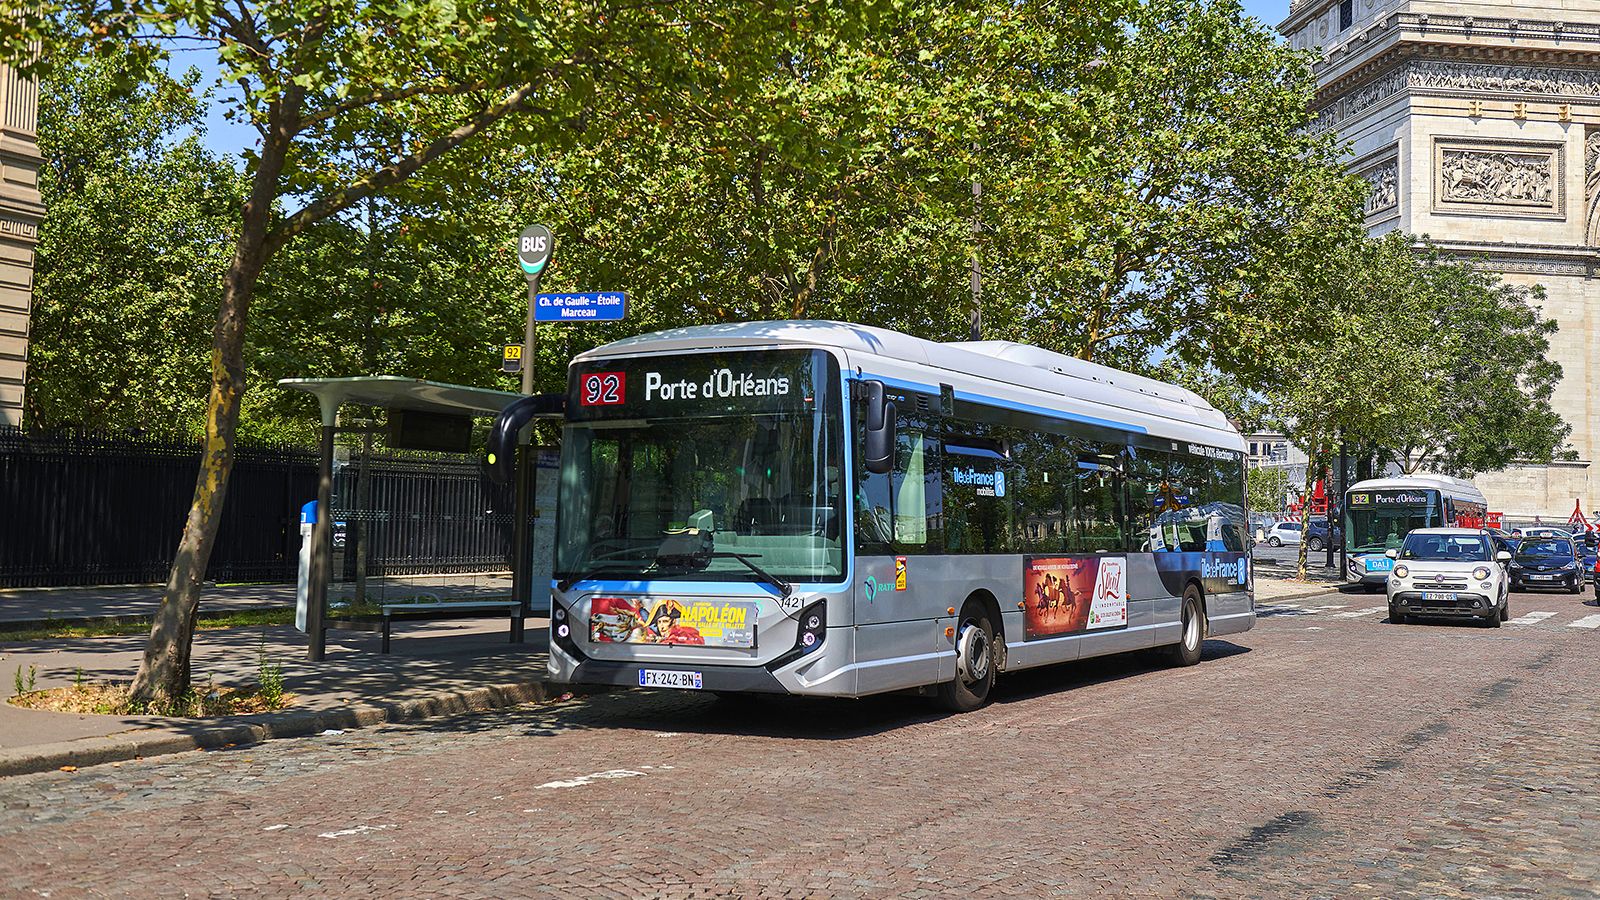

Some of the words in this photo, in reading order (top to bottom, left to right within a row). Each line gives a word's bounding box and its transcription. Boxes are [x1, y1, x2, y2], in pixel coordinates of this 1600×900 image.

[521, 236, 547, 253] BUS
[539, 297, 552, 307] Ch.
[553, 296, 563, 306] de
[565, 296, 590, 306] Gaulle
[597, 294, 620, 305] Étoile
[561, 307, 597, 318] Marceau
[507, 348, 519, 358] 92
[586, 374, 620, 404] 92
[645, 371, 698, 400] Porte
[702, 368, 790, 399] d'Orléans
[1354, 494, 1366, 503] 92
[1375, 494, 1395, 504] Porte
[878, 583, 896, 592] RATP
[1098, 562, 1121, 601] Spirit
[780, 597, 805, 608] 1421
[680, 602, 747, 623] NAPOLÉON
